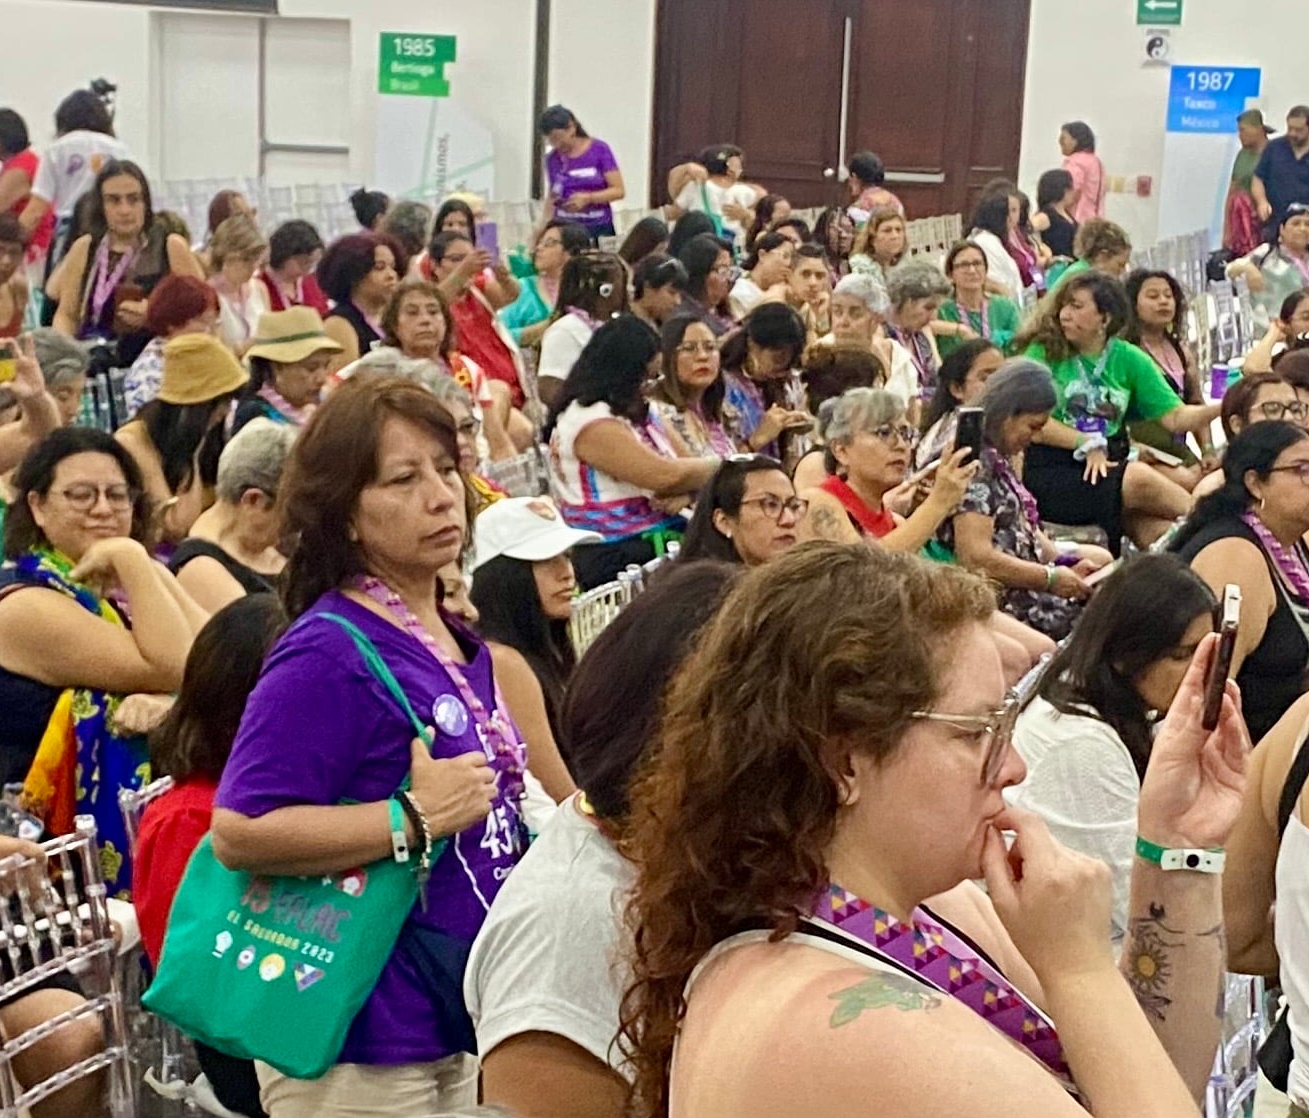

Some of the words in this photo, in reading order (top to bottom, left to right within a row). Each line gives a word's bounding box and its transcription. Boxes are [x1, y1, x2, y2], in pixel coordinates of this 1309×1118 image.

[393, 37, 437, 57] 1985
[1186, 71, 1235, 91] 1987
[300, 941, 335, 964] 2023
